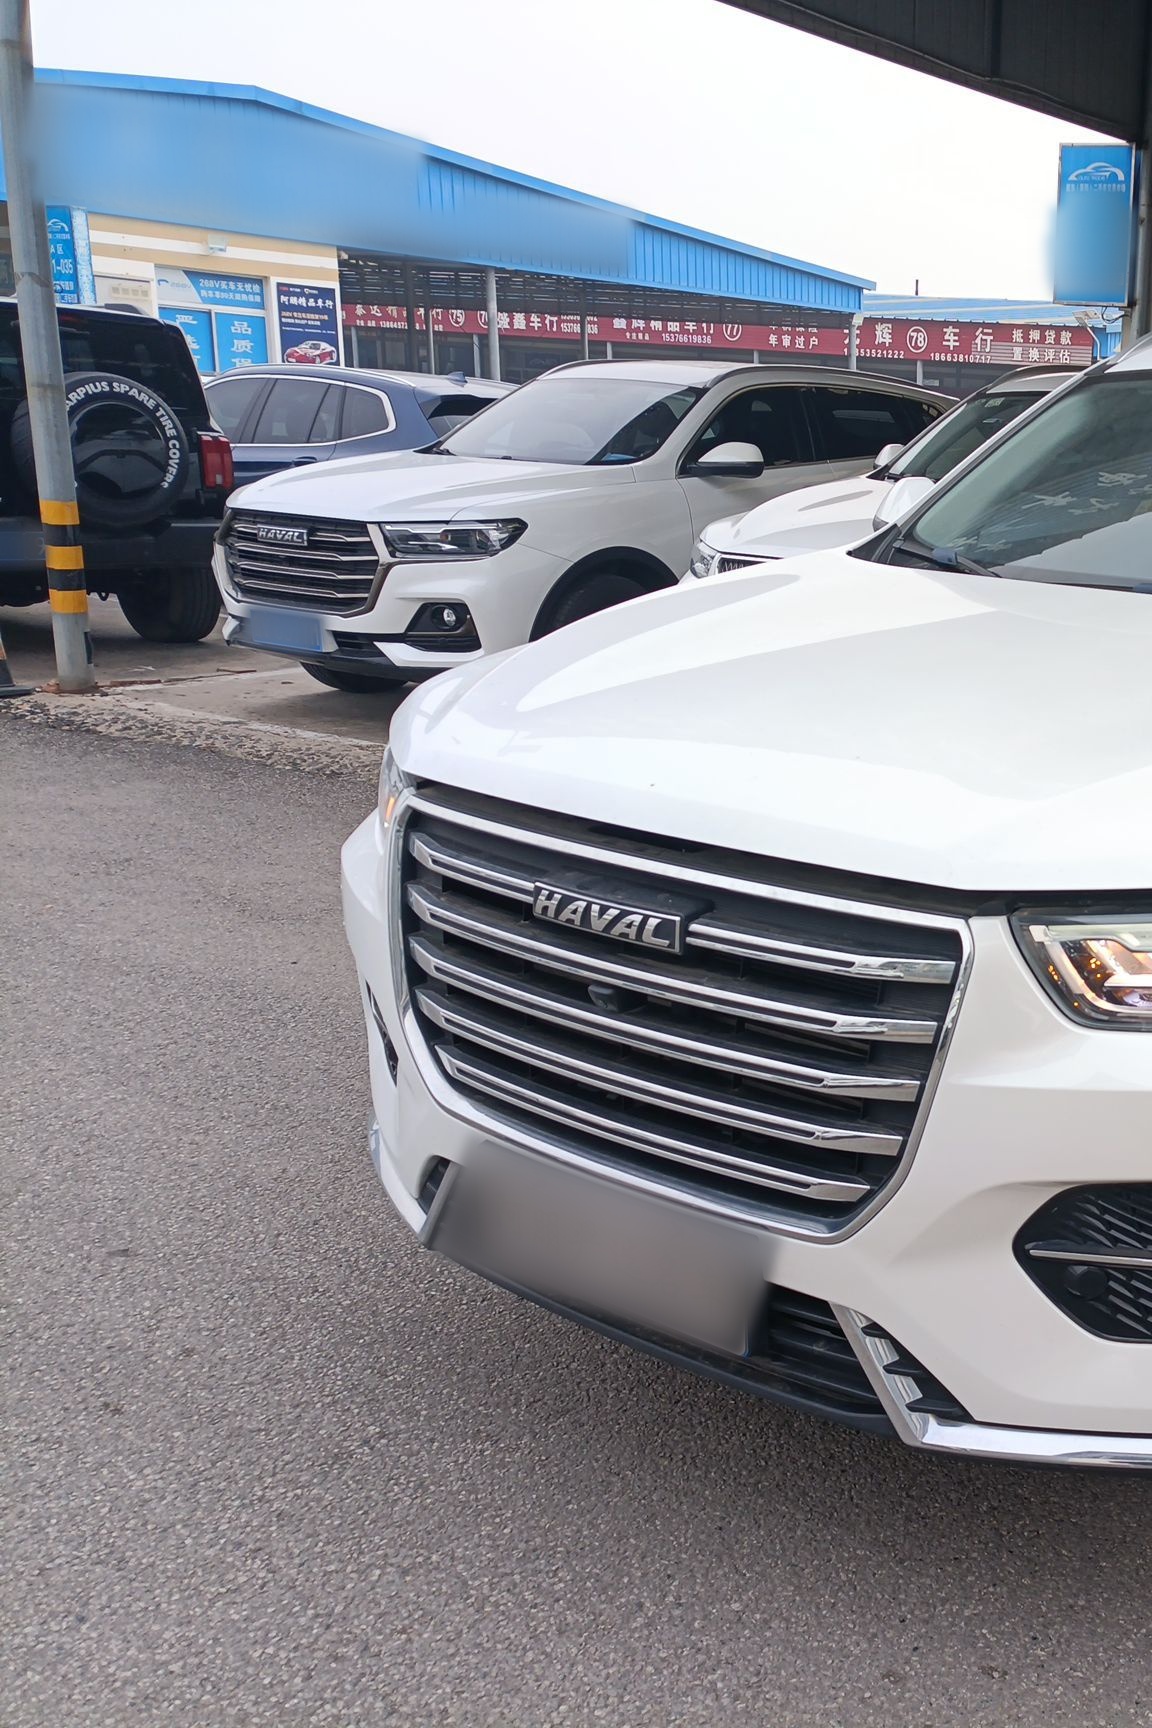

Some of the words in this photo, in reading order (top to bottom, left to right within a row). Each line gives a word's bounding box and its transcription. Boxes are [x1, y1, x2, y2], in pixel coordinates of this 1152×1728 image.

[662, 333, 712, 344] 15376619836
[768, 333, 819, 349] 年审过户
[942, 326, 993, 352] 车行
[1012, 328, 1072, 345] 抵押贷款
[930, 352, 991, 364] 18663810717
[1012, 347, 1070, 364] 置换评估
[112, 382, 156, 410] SPARE
[155, 405, 177, 438] TIRE
[259, 527, 304, 543] HAVAL
[535, 889, 671, 947] HAVAL
